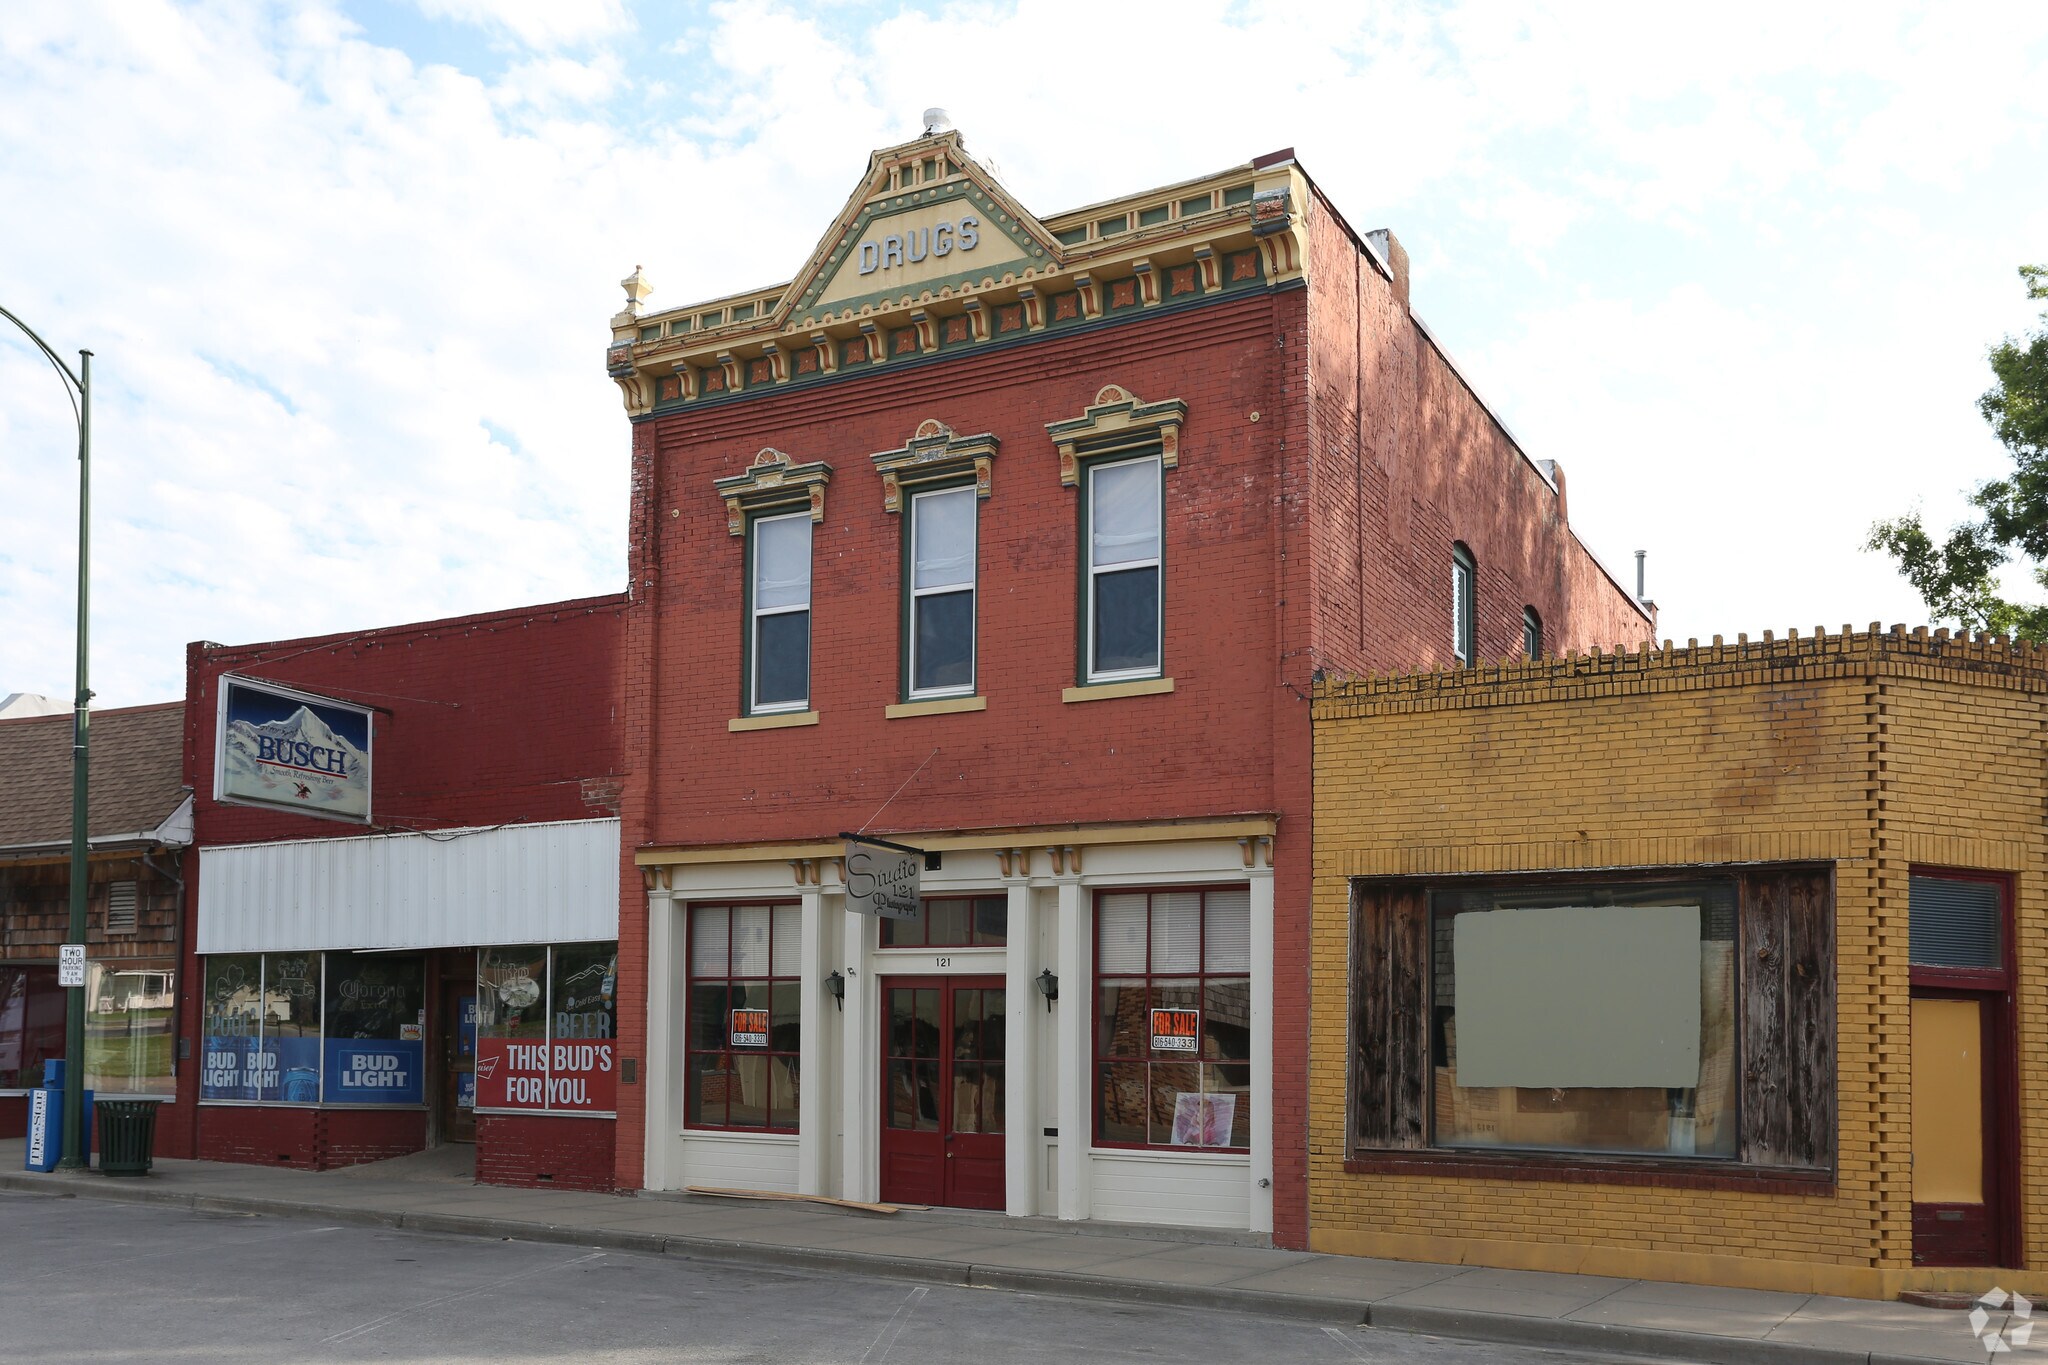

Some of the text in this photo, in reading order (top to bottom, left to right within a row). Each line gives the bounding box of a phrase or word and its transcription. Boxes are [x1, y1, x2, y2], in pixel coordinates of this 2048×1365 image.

[858, 215, 980, 276] DRUGS
[256, 734, 347, 775] BUSCH
[848, 853, 917, 898] Studio
[893, 884, 915, 899] 121
[62, 957, 83, 965] HOUR
[65, 949, 81, 957] TWO
[935, 958, 951, 967] 121
[556, 1011, 610, 1038] BEER
[734, 1012, 767, 1032] FOR SALE
[1153, 1012, 1196, 1036] FOR SALE
[207, 1052, 237, 1069] BUD
[246, 1052, 277, 1070] BUD
[352, 1055, 399, 1070] BUD
[506, 1045, 612, 1071] THIS BUD'S
[203, 1069, 240, 1087] LIGHT
[243, 1070, 280, 1088] LIGHT
[343, 1071, 407, 1087] LIGHT
[506, 1077, 592, 1104] FOR YOU.
